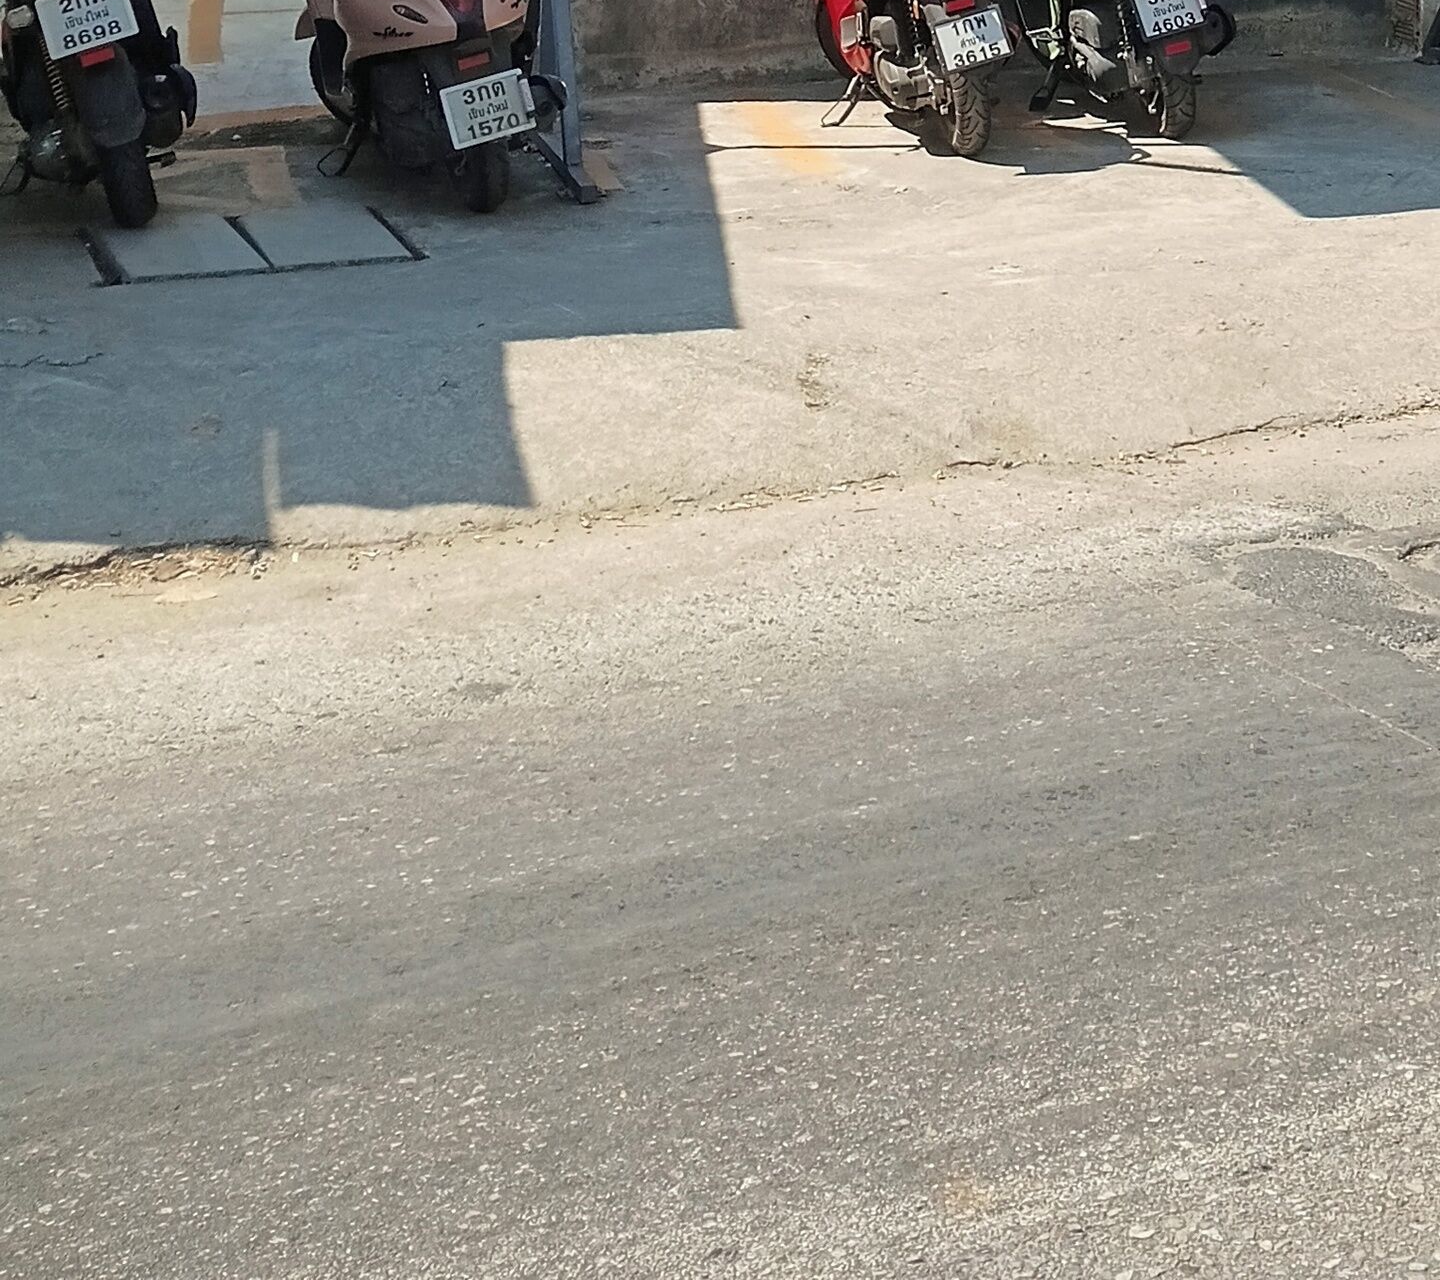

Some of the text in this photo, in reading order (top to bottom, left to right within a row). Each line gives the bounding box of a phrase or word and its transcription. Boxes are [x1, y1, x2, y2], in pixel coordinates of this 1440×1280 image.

[62, 20, 122, 50] 8698
[1152, 12, 1196, 33] 4603
[953, 42, 1002, 67] 3615
[467, 113, 520, 140] 1570
